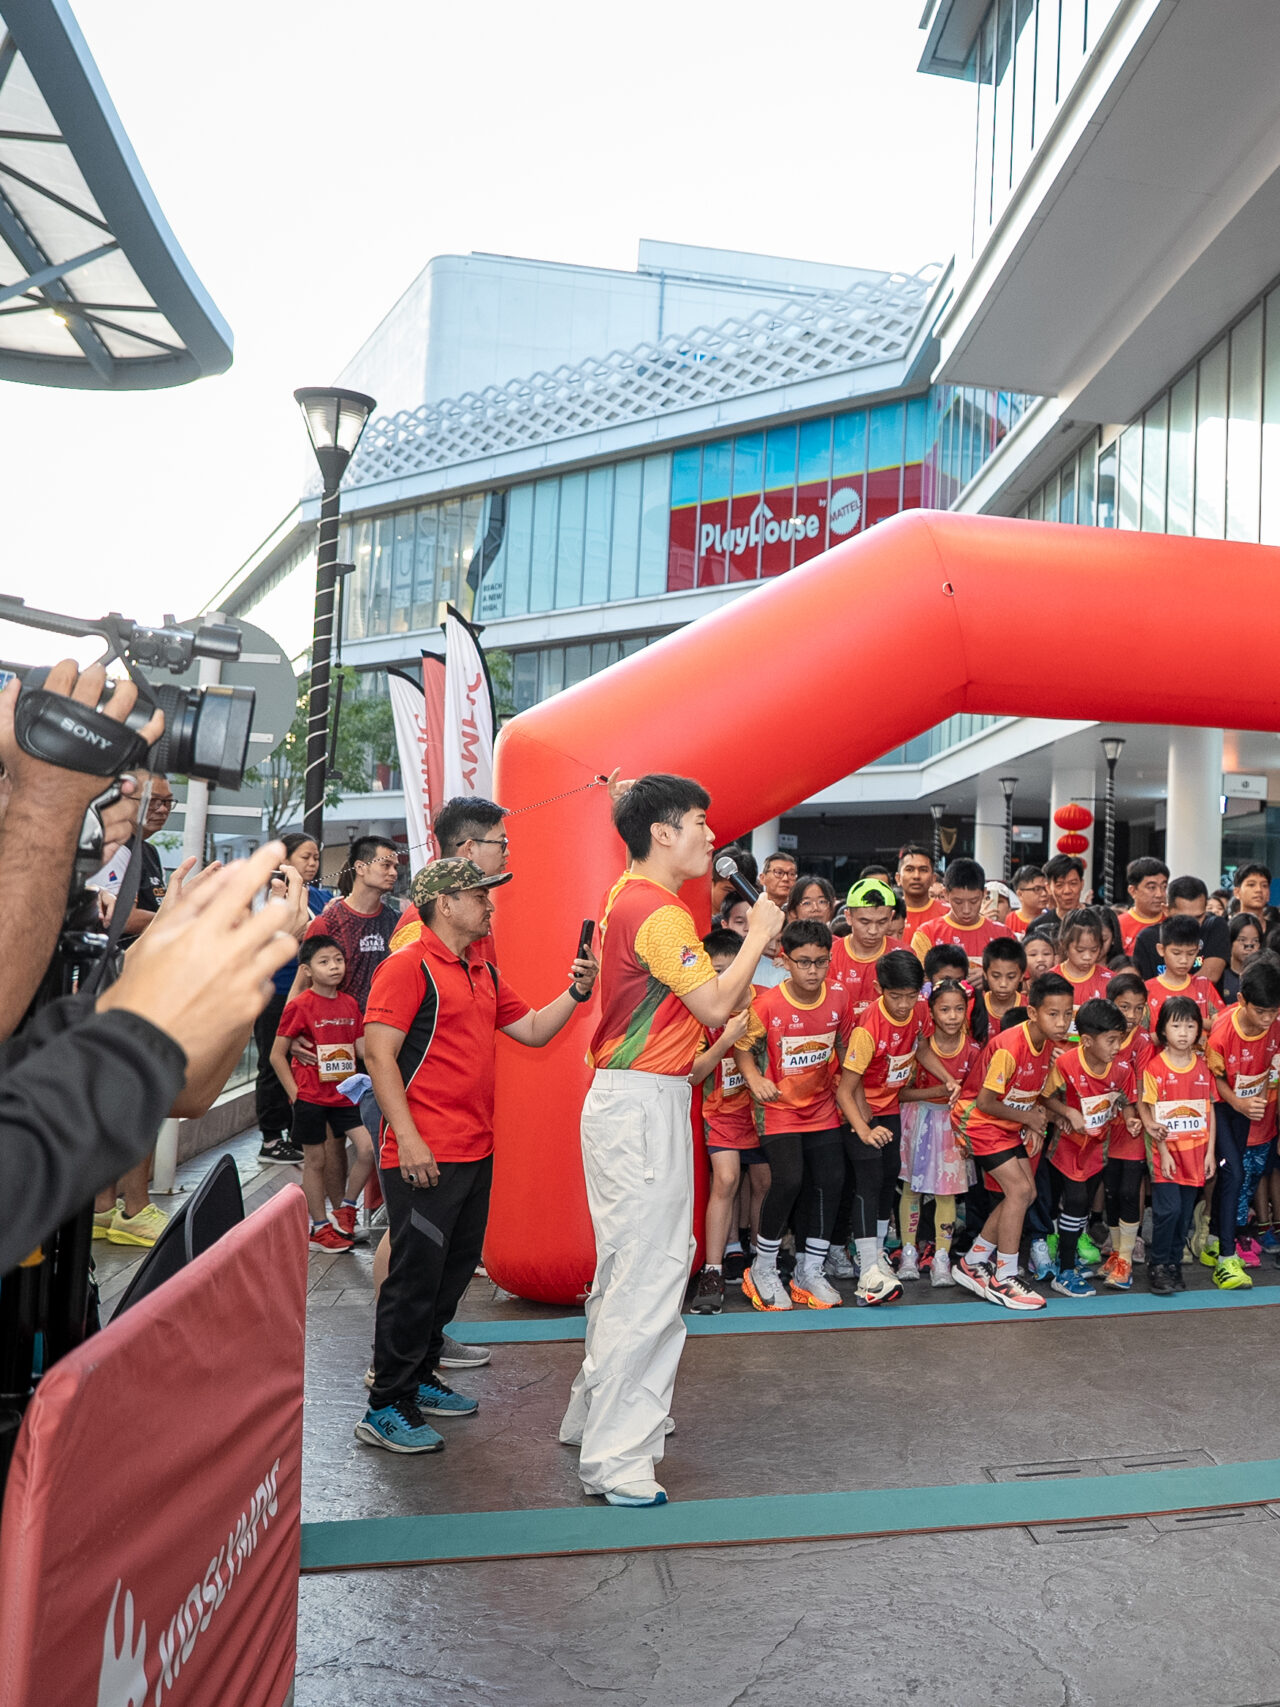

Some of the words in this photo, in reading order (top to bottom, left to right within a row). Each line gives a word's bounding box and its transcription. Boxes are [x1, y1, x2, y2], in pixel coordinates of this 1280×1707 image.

[830, 499, 862, 522] MATTEL
[60, 717, 112, 749] SONY
[790, 1055, 809, 1066] AM
[810, 1051, 827, 1063] 048
[325, 1062, 340, 1072] BM
[341, 1061, 353, 1071] 300
[729, 1074, 745, 1087] BM
[896, 1069, 908, 1080] AF
[1241, 1088, 1257, 1097] BM
[1167, 1120, 1180, 1130] AF
[1183, 1120, 1200, 1129] 110
[155, 1457, 280, 1707] KIDSLYMPIC
